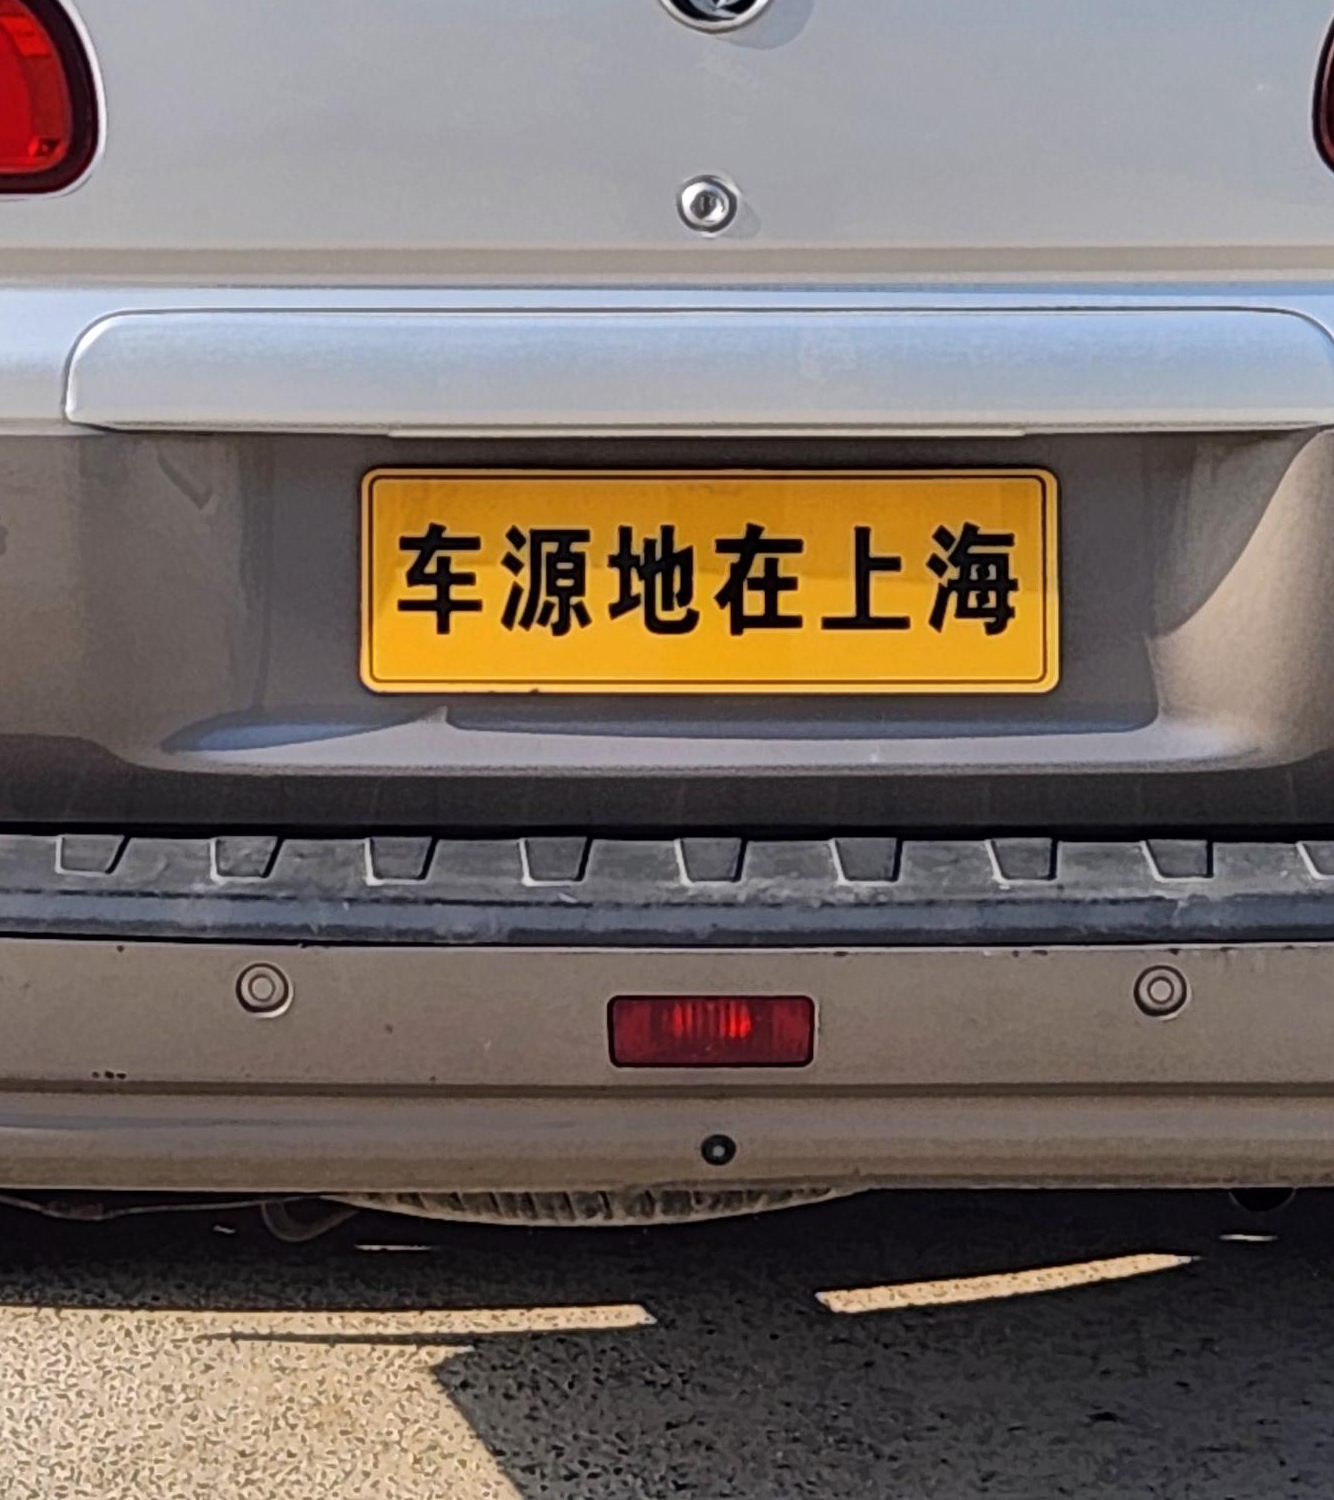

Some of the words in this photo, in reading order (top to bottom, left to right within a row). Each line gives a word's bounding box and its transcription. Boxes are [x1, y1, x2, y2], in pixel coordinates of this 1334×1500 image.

[396, 521, 1020, 638] 车源地在上海
